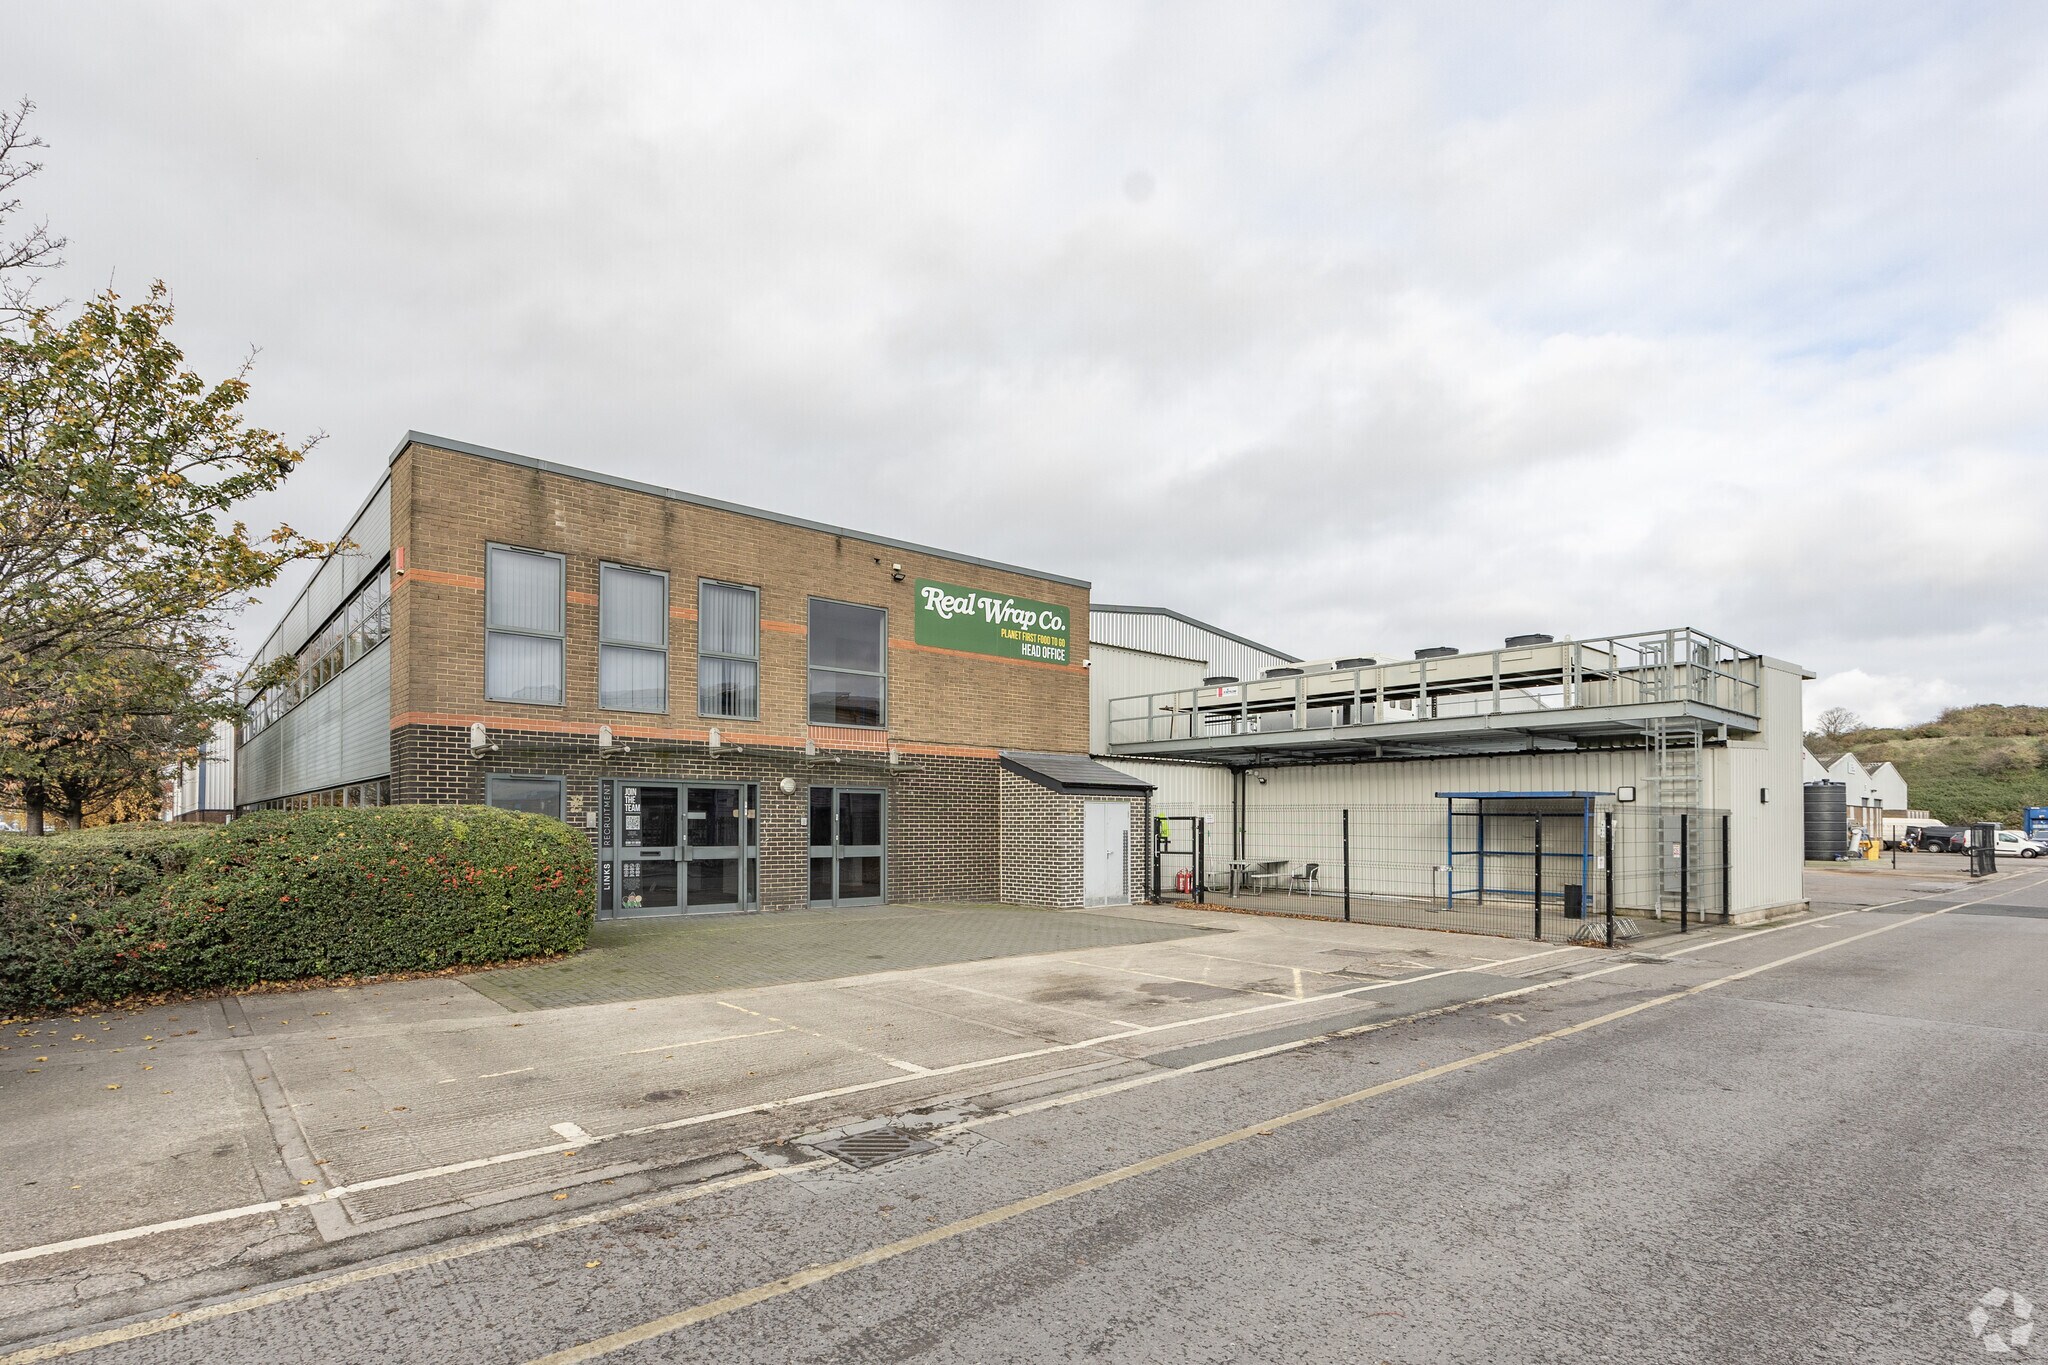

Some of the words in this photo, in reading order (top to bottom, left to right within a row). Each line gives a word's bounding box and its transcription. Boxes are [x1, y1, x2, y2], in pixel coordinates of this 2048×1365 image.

[921, 586, 976, 619] Real
[978, 598, 1037, 631] Wrap
[1039, 610, 1066, 631] Co.
[1001, 628, 1021, 640] PLANET
[1022, 631, 1037, 643] FIRST
[1037, 634, 1051, 645] FOOD
[1051, 636, 1058, 646] TO
[1058, 638, 1066, 648] GO
[1021, 643, 1041, 658] HEAD
[1042, 646, 1066, 661] OFFICE
[624, 787, 637, 796] JOIN
[624, 795, 636, 804] THE
[603, 783, 611, 846] RECRUITMENT
[624, 803, 641, 812] TEAM
[603, 863, 611, 891] LINKS
